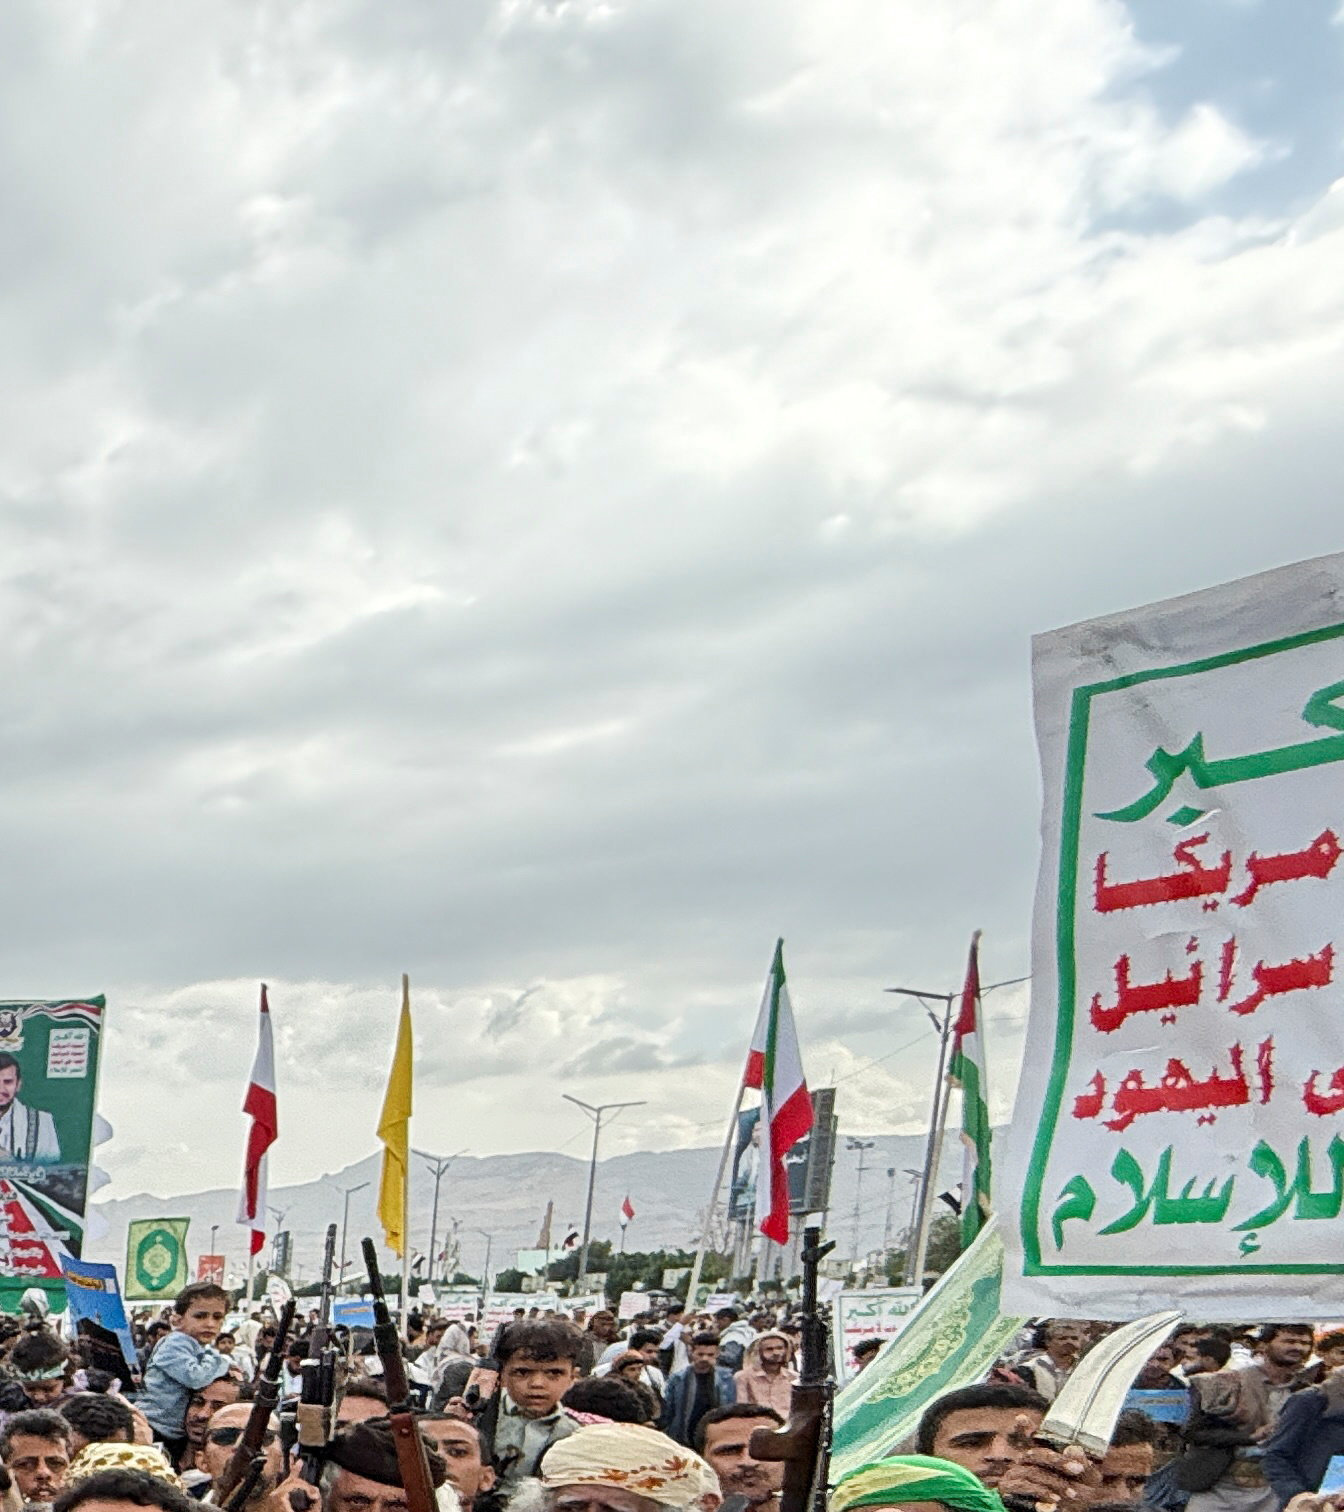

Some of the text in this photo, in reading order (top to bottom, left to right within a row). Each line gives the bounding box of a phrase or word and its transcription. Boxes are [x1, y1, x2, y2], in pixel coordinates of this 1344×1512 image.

[1092, 679, 1344, 828] كبر
[1092, 828, 1344, 914] مريكا
[1088, 934, 1335, 1034] سرائيل
[1071, 1034, 1277, 1132] اليهود
